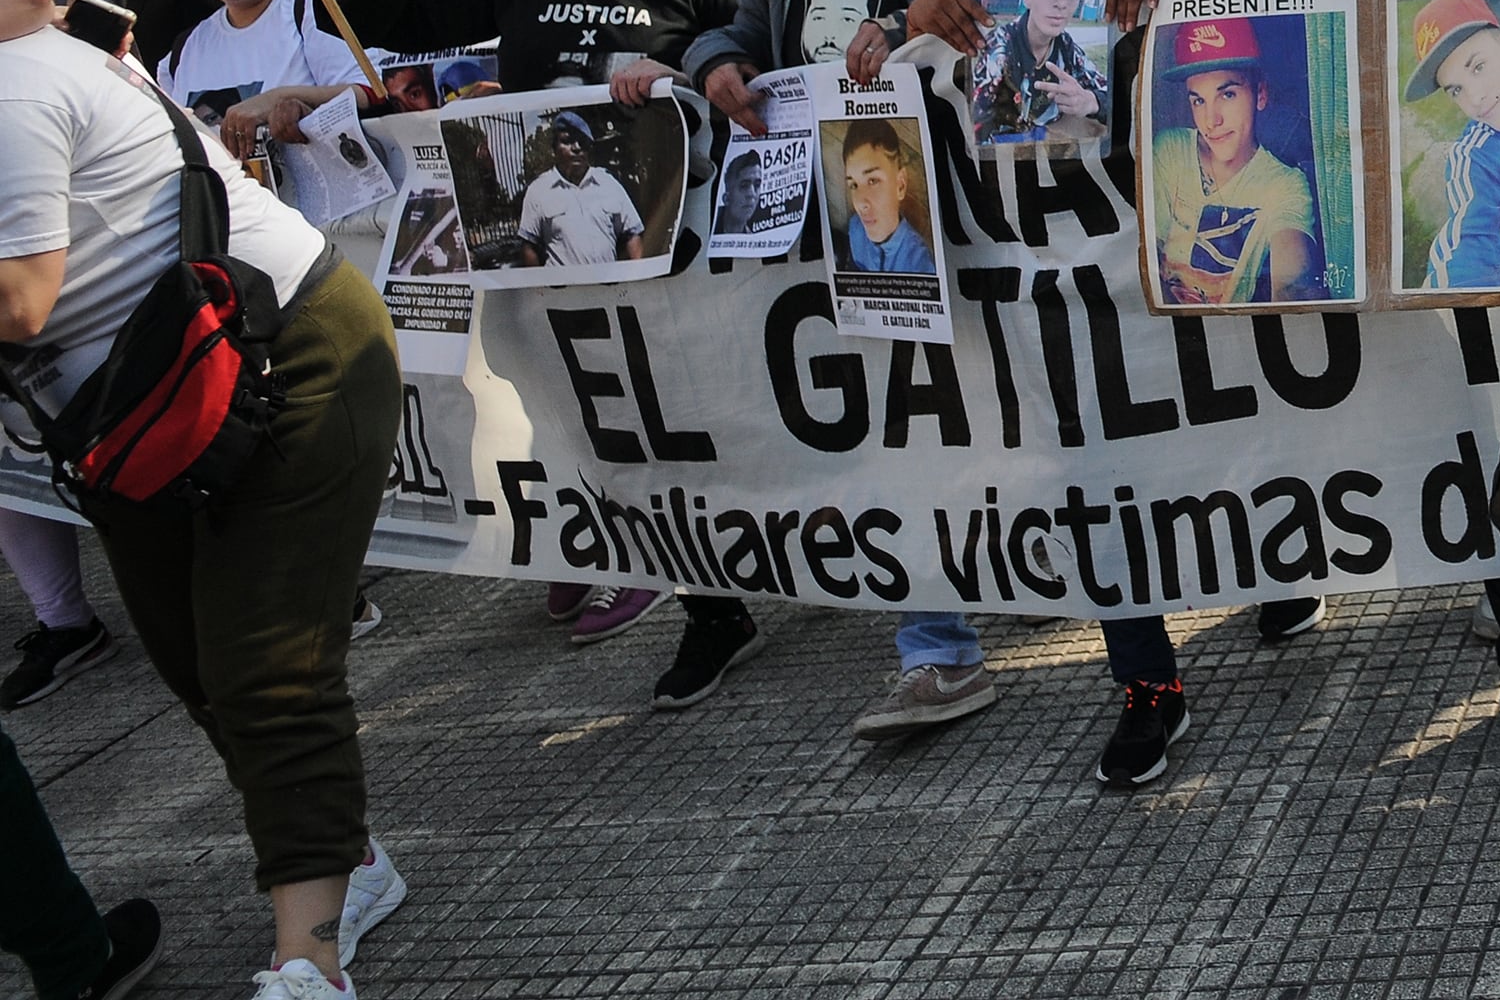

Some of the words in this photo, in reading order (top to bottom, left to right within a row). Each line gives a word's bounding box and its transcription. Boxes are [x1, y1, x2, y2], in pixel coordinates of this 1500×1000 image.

[538, 3, 653, 27] JUSTICIA
[578, 29, 598, 46] X
[844, 100, 898, 116] Romero
[414, 146, 440, 160] LUIS
[763, 141, 807, 170] BASTA
[760, 184, 804, 210] JUSTICIA
[763, 262, 1363, 454] GATILLO
[546, 304, 718, 465] EL
